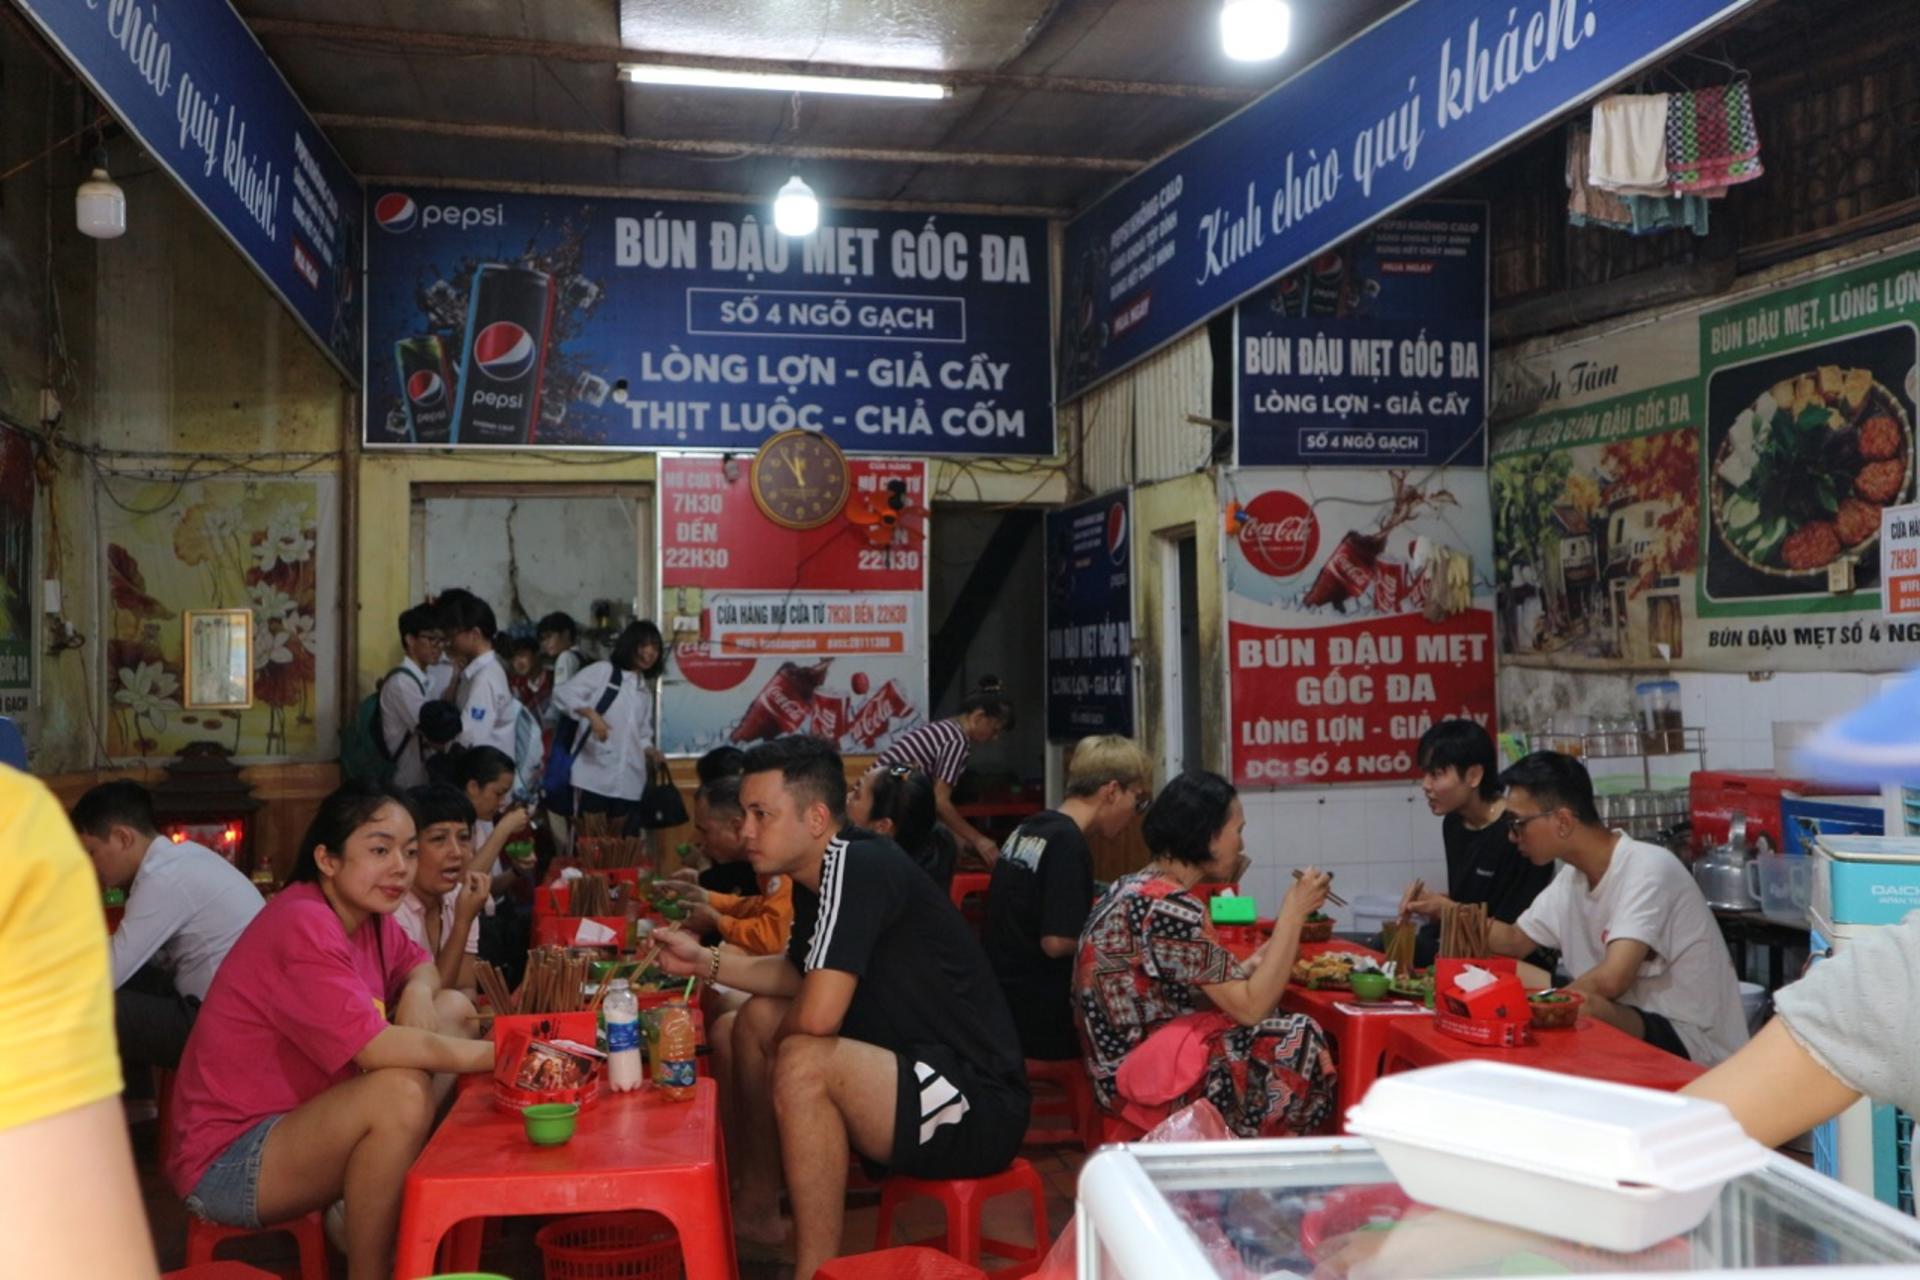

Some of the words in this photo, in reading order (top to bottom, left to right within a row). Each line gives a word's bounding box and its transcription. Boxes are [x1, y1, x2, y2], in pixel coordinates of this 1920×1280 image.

[1197, 182, 1264, 287] Kính
[1272, 148, 1342, 236] chào
[1353, 76, 1425, 197] quý
[421, 203, 504, 231] pepsi
[615, 210, 698, 269] BÚN
[709, 214, 790, 282] ĐẬU
[803, 225, 879, 285] MẸT
[891, 215, 969, 281] GỐC
[979, 232, 1031, 284] ĐA
[720, 295, 760, 324] SỐ
[766, 303, 781, 325] 4
[789, 298, 851, 327] NGÕ
[858, 306, 935, 335] GẠCH
[1711, 319, 1743, 355] BÚN
[1747, 307, 1780, 348] ĐẬU
[1784, 298, 1825, 338] MẸT,
[1830, 283, 1879, 323] LÒNG
[641, 344, 749, 384] LÒNG
[758, 354, 836, 394] LỢN
[867, 351, 932, 389] GIẢ
[939, 352, 1011, 391] CẦY
[1245, 330, 1291, 375] BÚN
[1297, 331, 1343, 383] ĐẬU
[1351, 338, 1394, 384] MẸT
[1400, 327, 1445, 379] GỐC
[1450, 341, 1479, 379] ĐA
[472, 389, 524, 410] pepsi
[1254, 389, 1317, 414] LÒNG
[1323, 393, 1368, 419] LỢN
[1386, 391, 1423, 415] GIẢ
[625, 402, 710, 440] THỊT
[855, 399, 933, 436] CHẢ
[941, 399, 1026, 438] CỐM
[1600, 402, 1633, 443] ĐẬU
[1633, 391, 1664, 432] GỐC
[1667, 393, 1691, 424] ĐA
[1307, 430, 1328, 449] SỐ
[1330, 435, 1339, 449] 4
[1343, 432, 1376, 449] NGÕ
[1378, 436, 1419, 453] GẠCH
[672, 493, 723, 513] 7H30
[676, 517, 718, 543] ĐẾN
[1891, 516, 1908, 540] CỬA
[665, 548, 729, 569] 22H30
[1890, 547, 1918, 571] 7H30
[717, 600, 737, 624] CỬA
[740, 602, 768, 624] HÀNG
[790, 600, 809, 624] CỬA
[812, 601, 826, 624] TỪ
[828, 604, 852, 624] 7H30
[854, 599, 875, 624] ĐẾN
[878, 605, 907, 624] 22H30
[1239, 634, 1315, 669] BÚN
[1328, 631, 1403, 670] ĐẬU
[1415, 633, 1487, 668] MẸT
[1708, 626, 1743, 648] BÚN
[1747, 624, 1788, 651] ĐẬU
[1793, 627, 1837, 650] MẸT
[1839, 617, 1863, 645] SỐ
[1868, 624, 1881, 643] 4
[1296, 666, 1374, 706] GỐC
[1386, 673, 1436, 703] ĐA
[1242, 716, 1308, 746] LÒNG
[1317, 714, 1365, 747] LỢN
[1295, 751, 1329, 776] SỐ
[1335, 756, 1352, 775] 4
[1357, 750, 1412, 775] NGÕ
